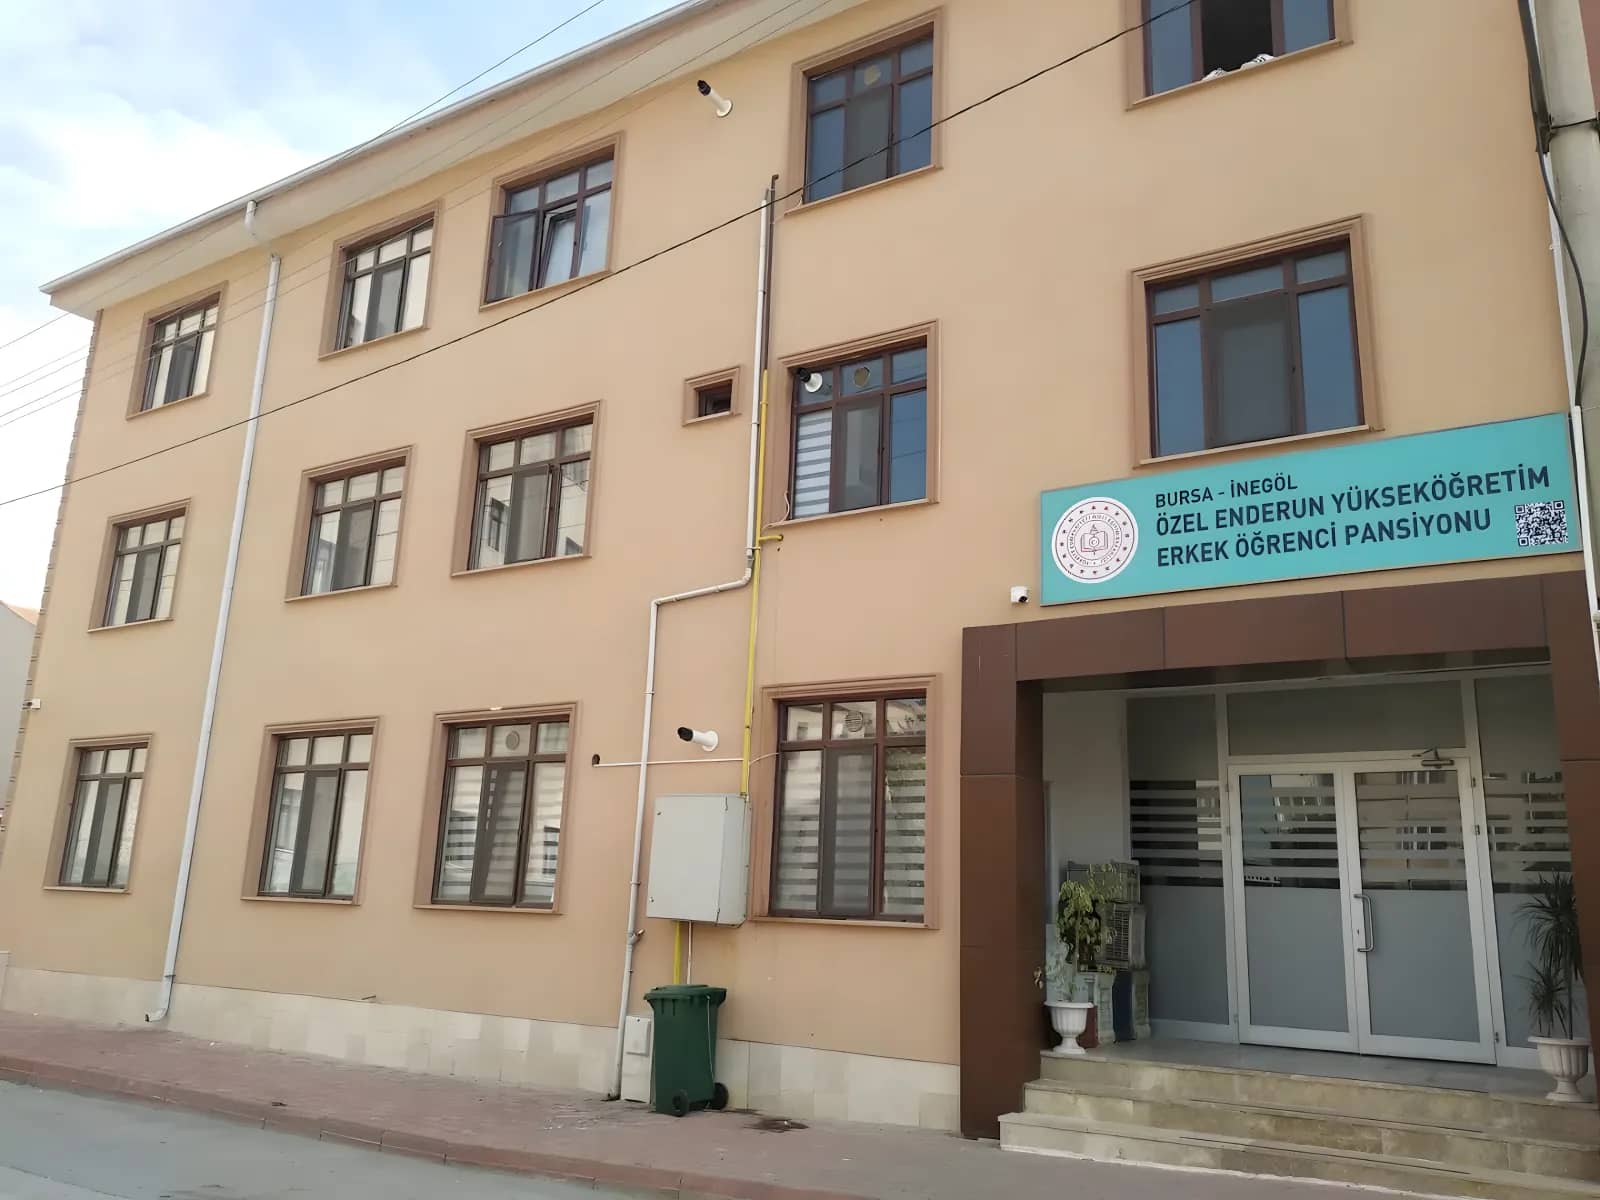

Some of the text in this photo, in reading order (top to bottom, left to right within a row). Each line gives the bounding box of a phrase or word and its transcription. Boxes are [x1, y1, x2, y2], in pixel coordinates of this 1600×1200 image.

[1155, 486, 1214, 508] BURSA
[1230, 472, 1299, 499] İNEGÖL
[1156, 463, 1550, 537] ÖZEL ENDERUN YÜKSEKÖĞRETİM
[1157, 539, 1230, 568] ERKEK
[1235, 521, 1337, 558] ÖĞRENCİ
[1344, 507, 1492, 546] PANSİYONU
